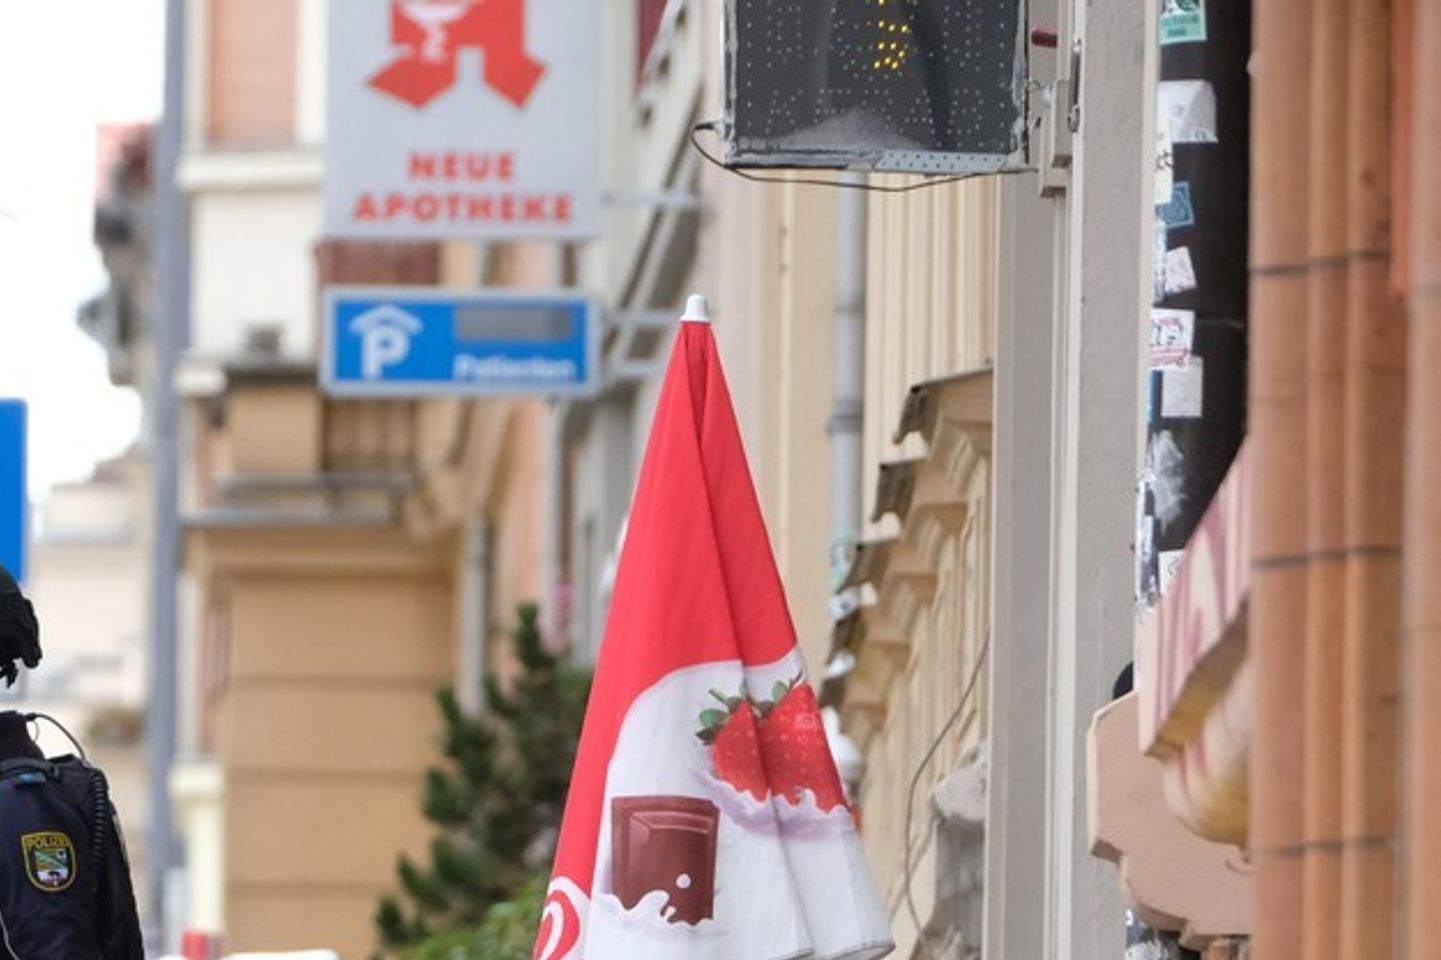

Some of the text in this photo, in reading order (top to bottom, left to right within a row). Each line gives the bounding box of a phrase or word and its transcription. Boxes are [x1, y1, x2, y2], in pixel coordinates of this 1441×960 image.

[407, 151, 515, 182] NEUE
[353, 192, 573, 223] APOTHEKE
[361, 326, 410, 379] P
